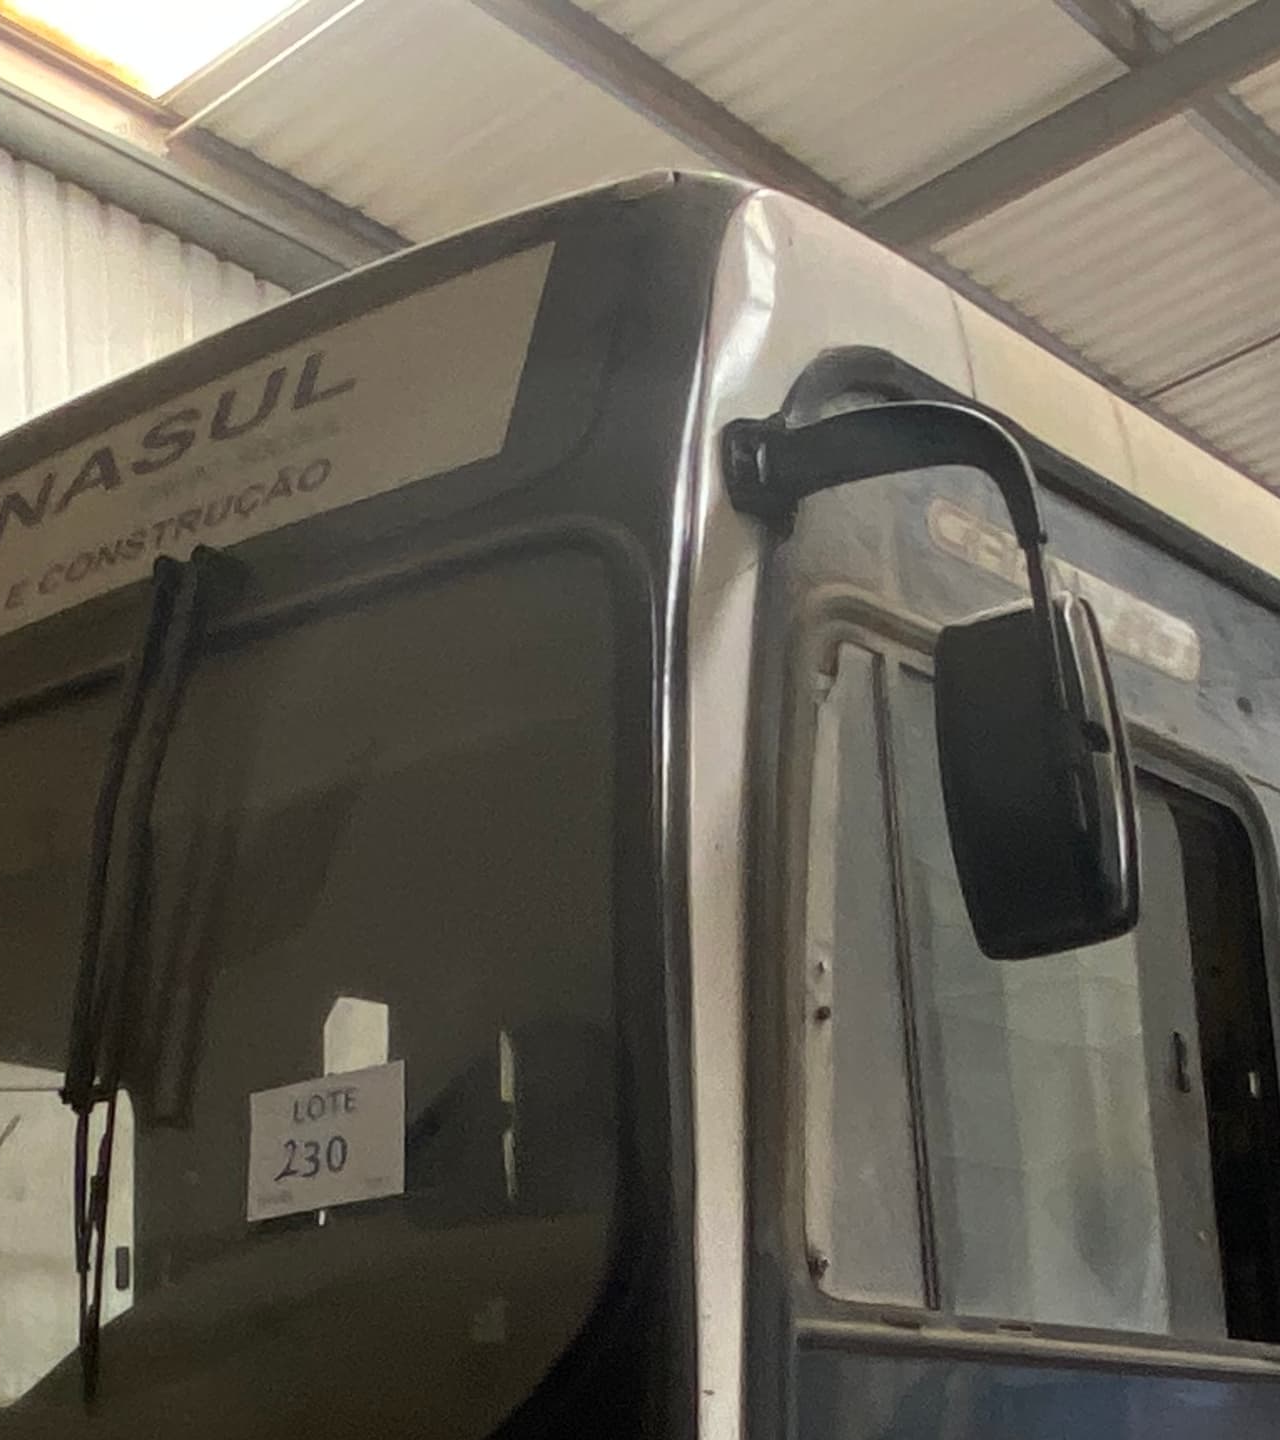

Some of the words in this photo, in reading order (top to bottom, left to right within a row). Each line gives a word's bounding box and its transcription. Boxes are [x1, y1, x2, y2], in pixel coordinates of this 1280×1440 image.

[37, 457, 333, 596] CONSTRUÇÃO
[291, 1086, 361, 1124] LOTE
[273, 1135, 349, 1182] 230
